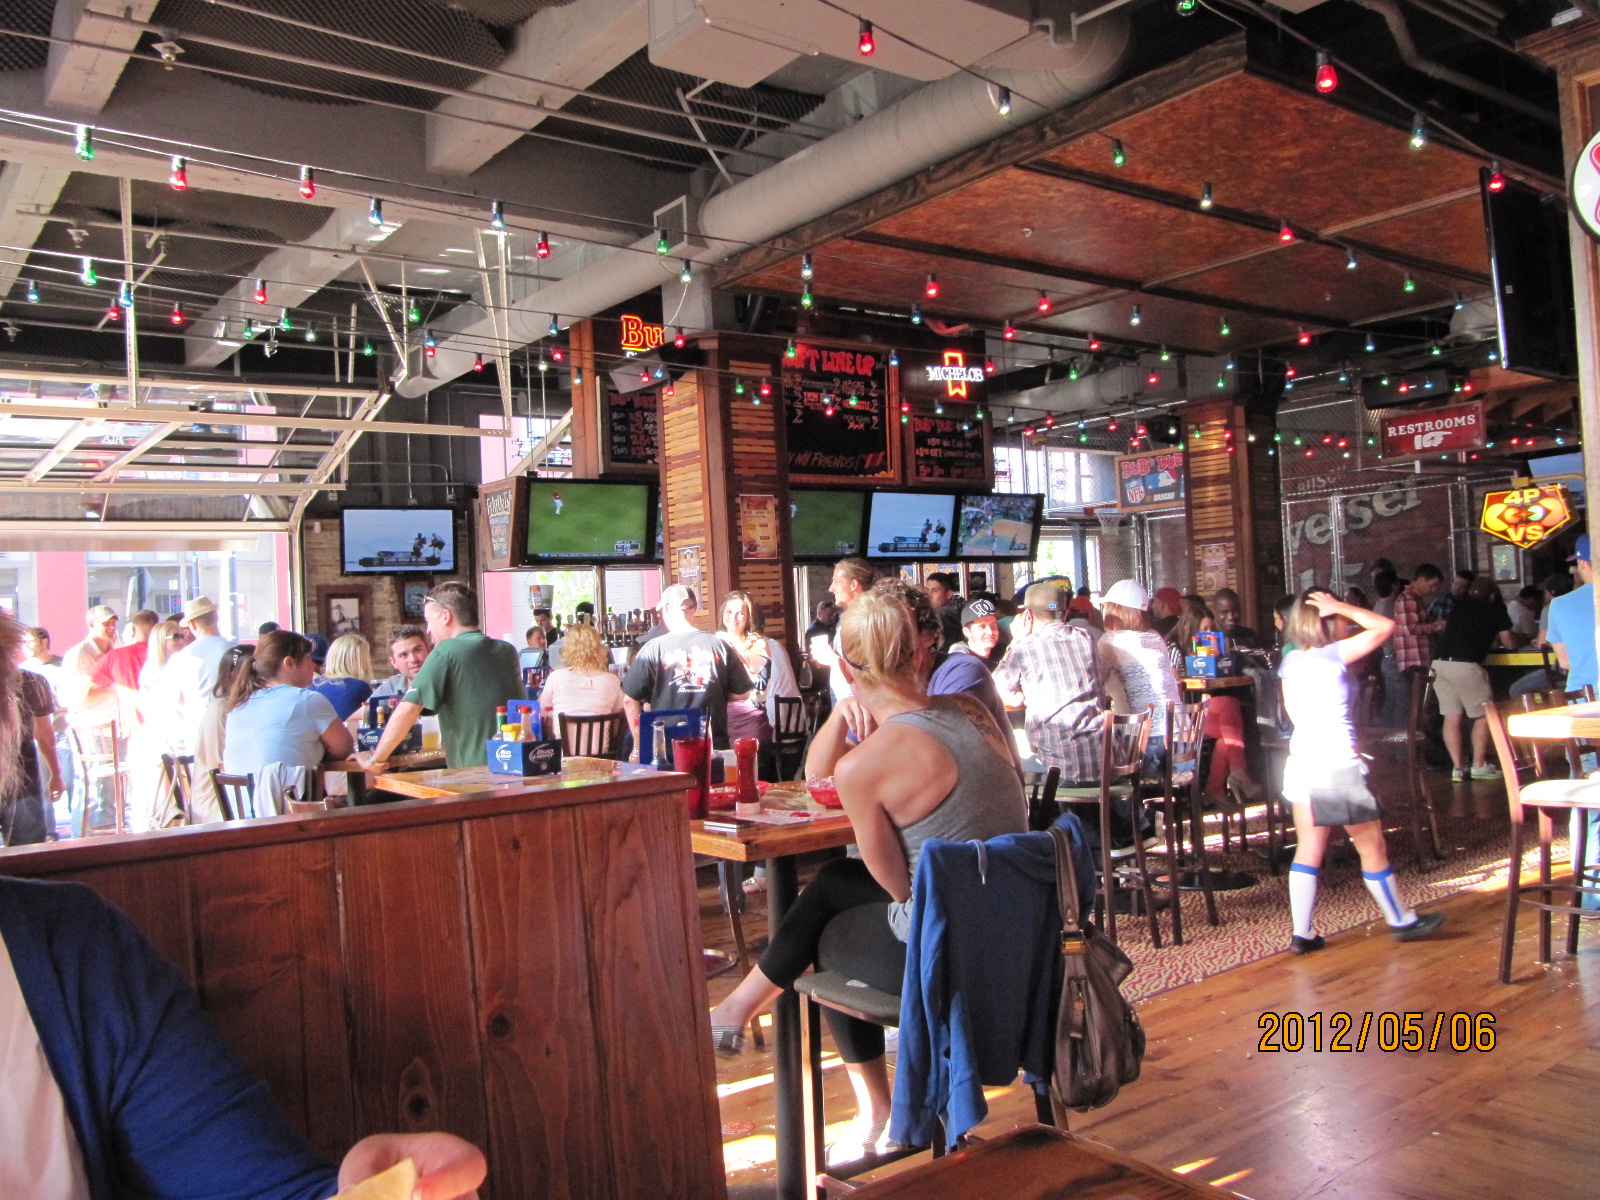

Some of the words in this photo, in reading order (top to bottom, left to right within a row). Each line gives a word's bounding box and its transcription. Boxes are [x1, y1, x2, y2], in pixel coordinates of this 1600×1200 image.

[822, 351, 855, 374] LINE
[856, 353, 875, 377] UP
[926, 366, 984, 382] MICHELOB
[1387, 415, 1476, 437] RESTROOMS
[1503, 489, 1541, 504] 4P
[1507, 525, 1543, 542] VS
